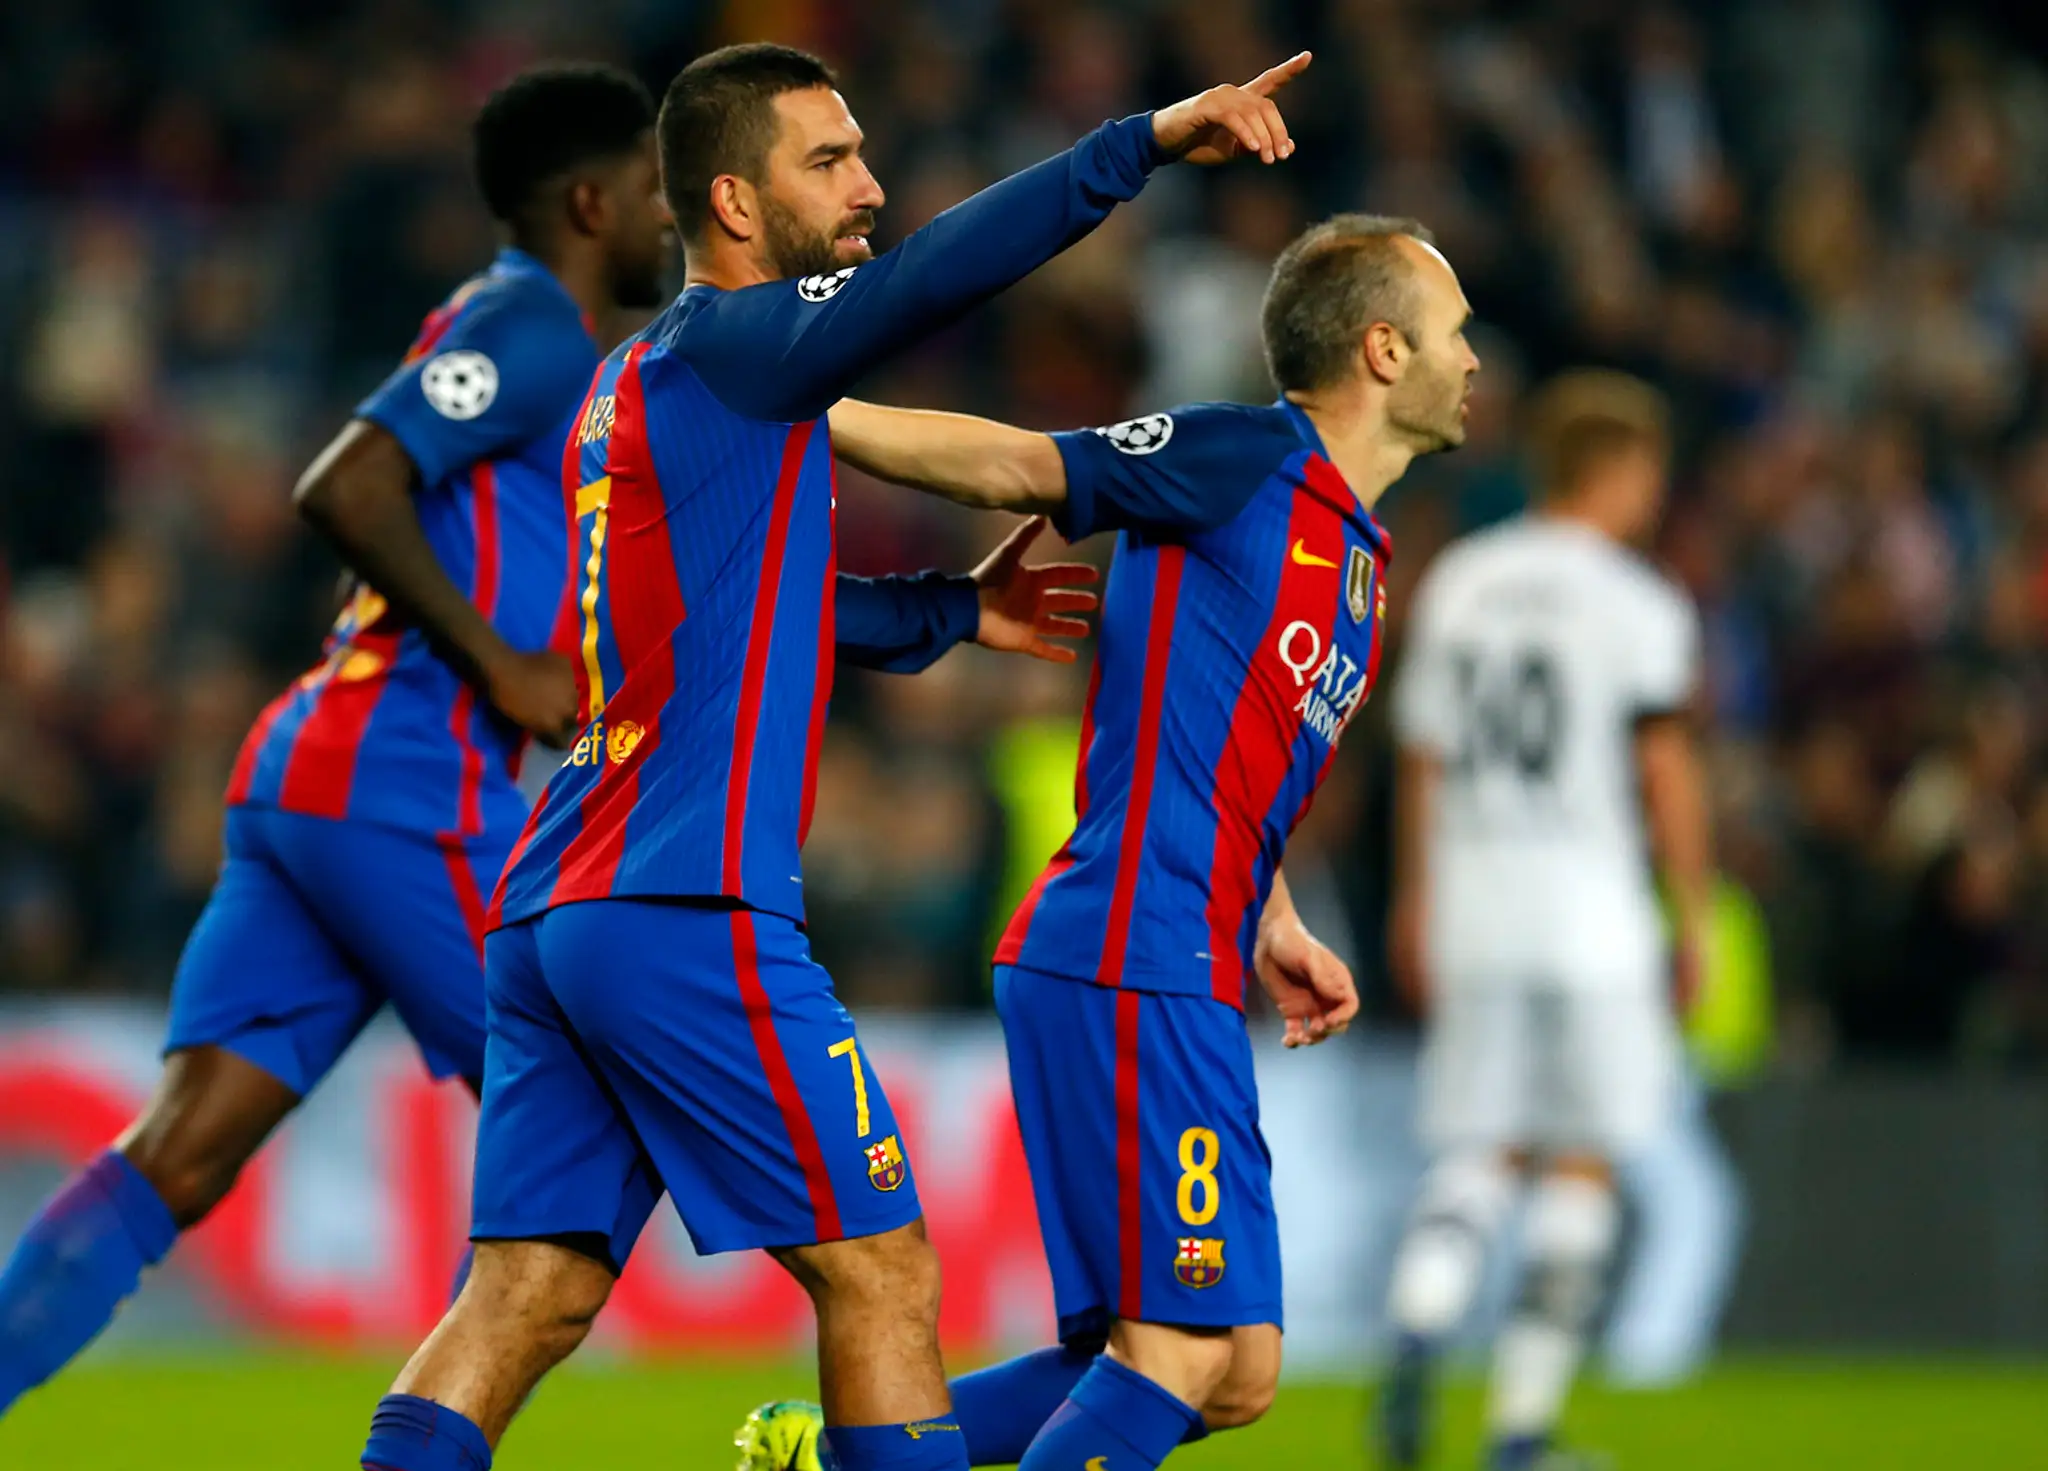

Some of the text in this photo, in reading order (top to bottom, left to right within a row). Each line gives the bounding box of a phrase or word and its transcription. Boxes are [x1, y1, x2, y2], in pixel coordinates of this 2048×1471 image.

[575, 475, 611, 719] 7
[561, 722, 603, 767] ef
[827, 1036, 870, 1139] 7
[1176, 1126, 1220, 1226] 8
